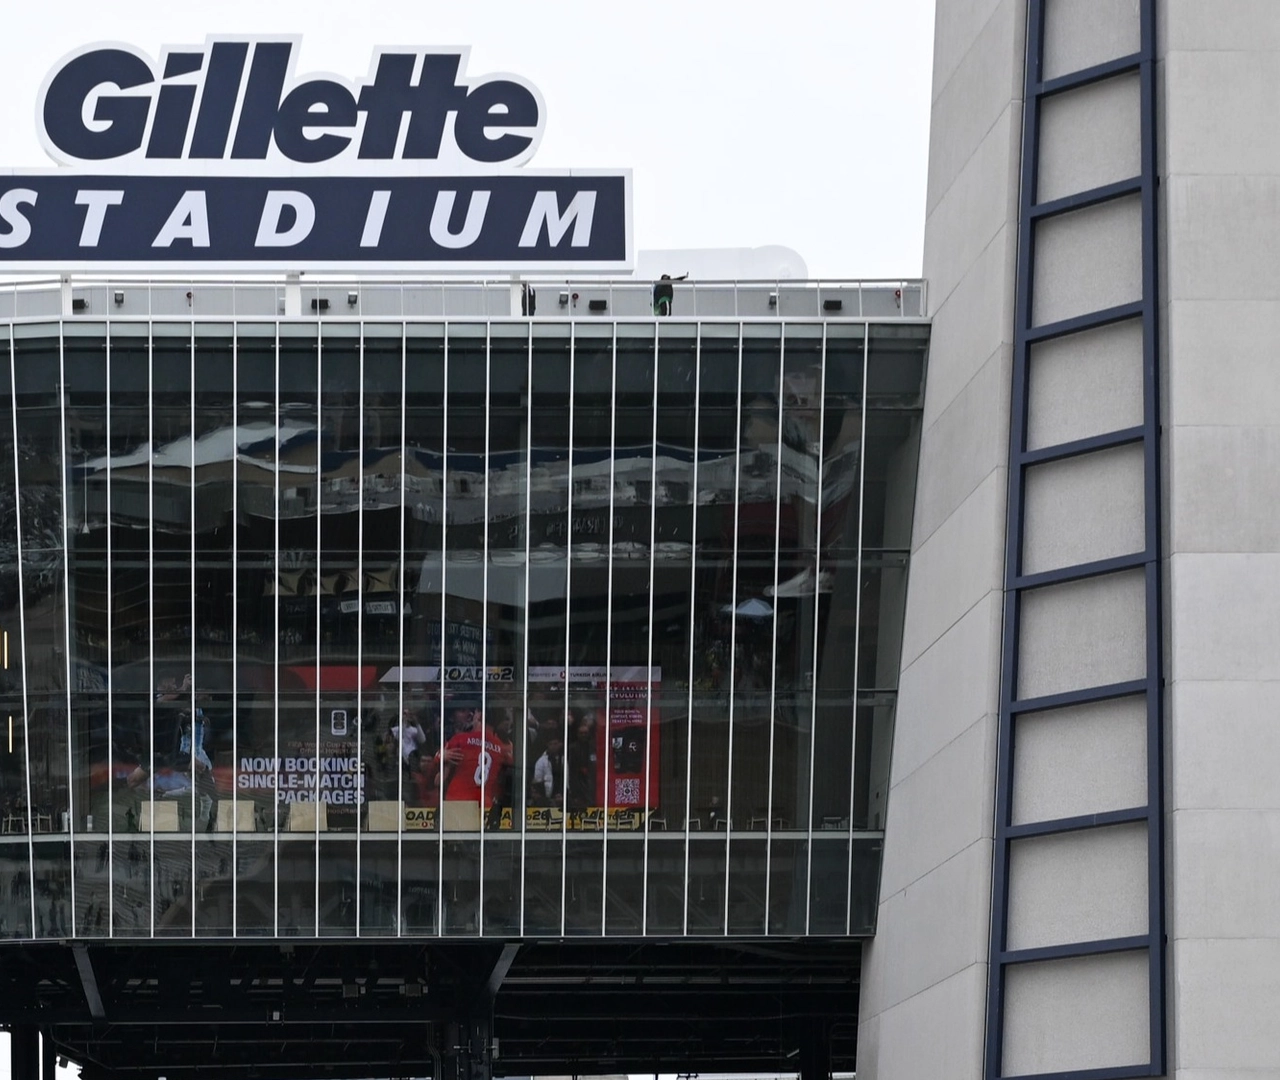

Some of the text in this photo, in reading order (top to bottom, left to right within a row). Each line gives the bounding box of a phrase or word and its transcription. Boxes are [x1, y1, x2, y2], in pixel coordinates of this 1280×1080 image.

[43, 41, 539, 163] Gillette
[436, 668, 483, 681] ROAD
[241, 757, 365, 772] NOW BOOKING:
[474, 751, 492, 787] 8
[238, 774, 365, 788] SINGLE-MATCH
[276, 790, 365, 804] PACKAGES
[406, 810, 434, 821] OAD
